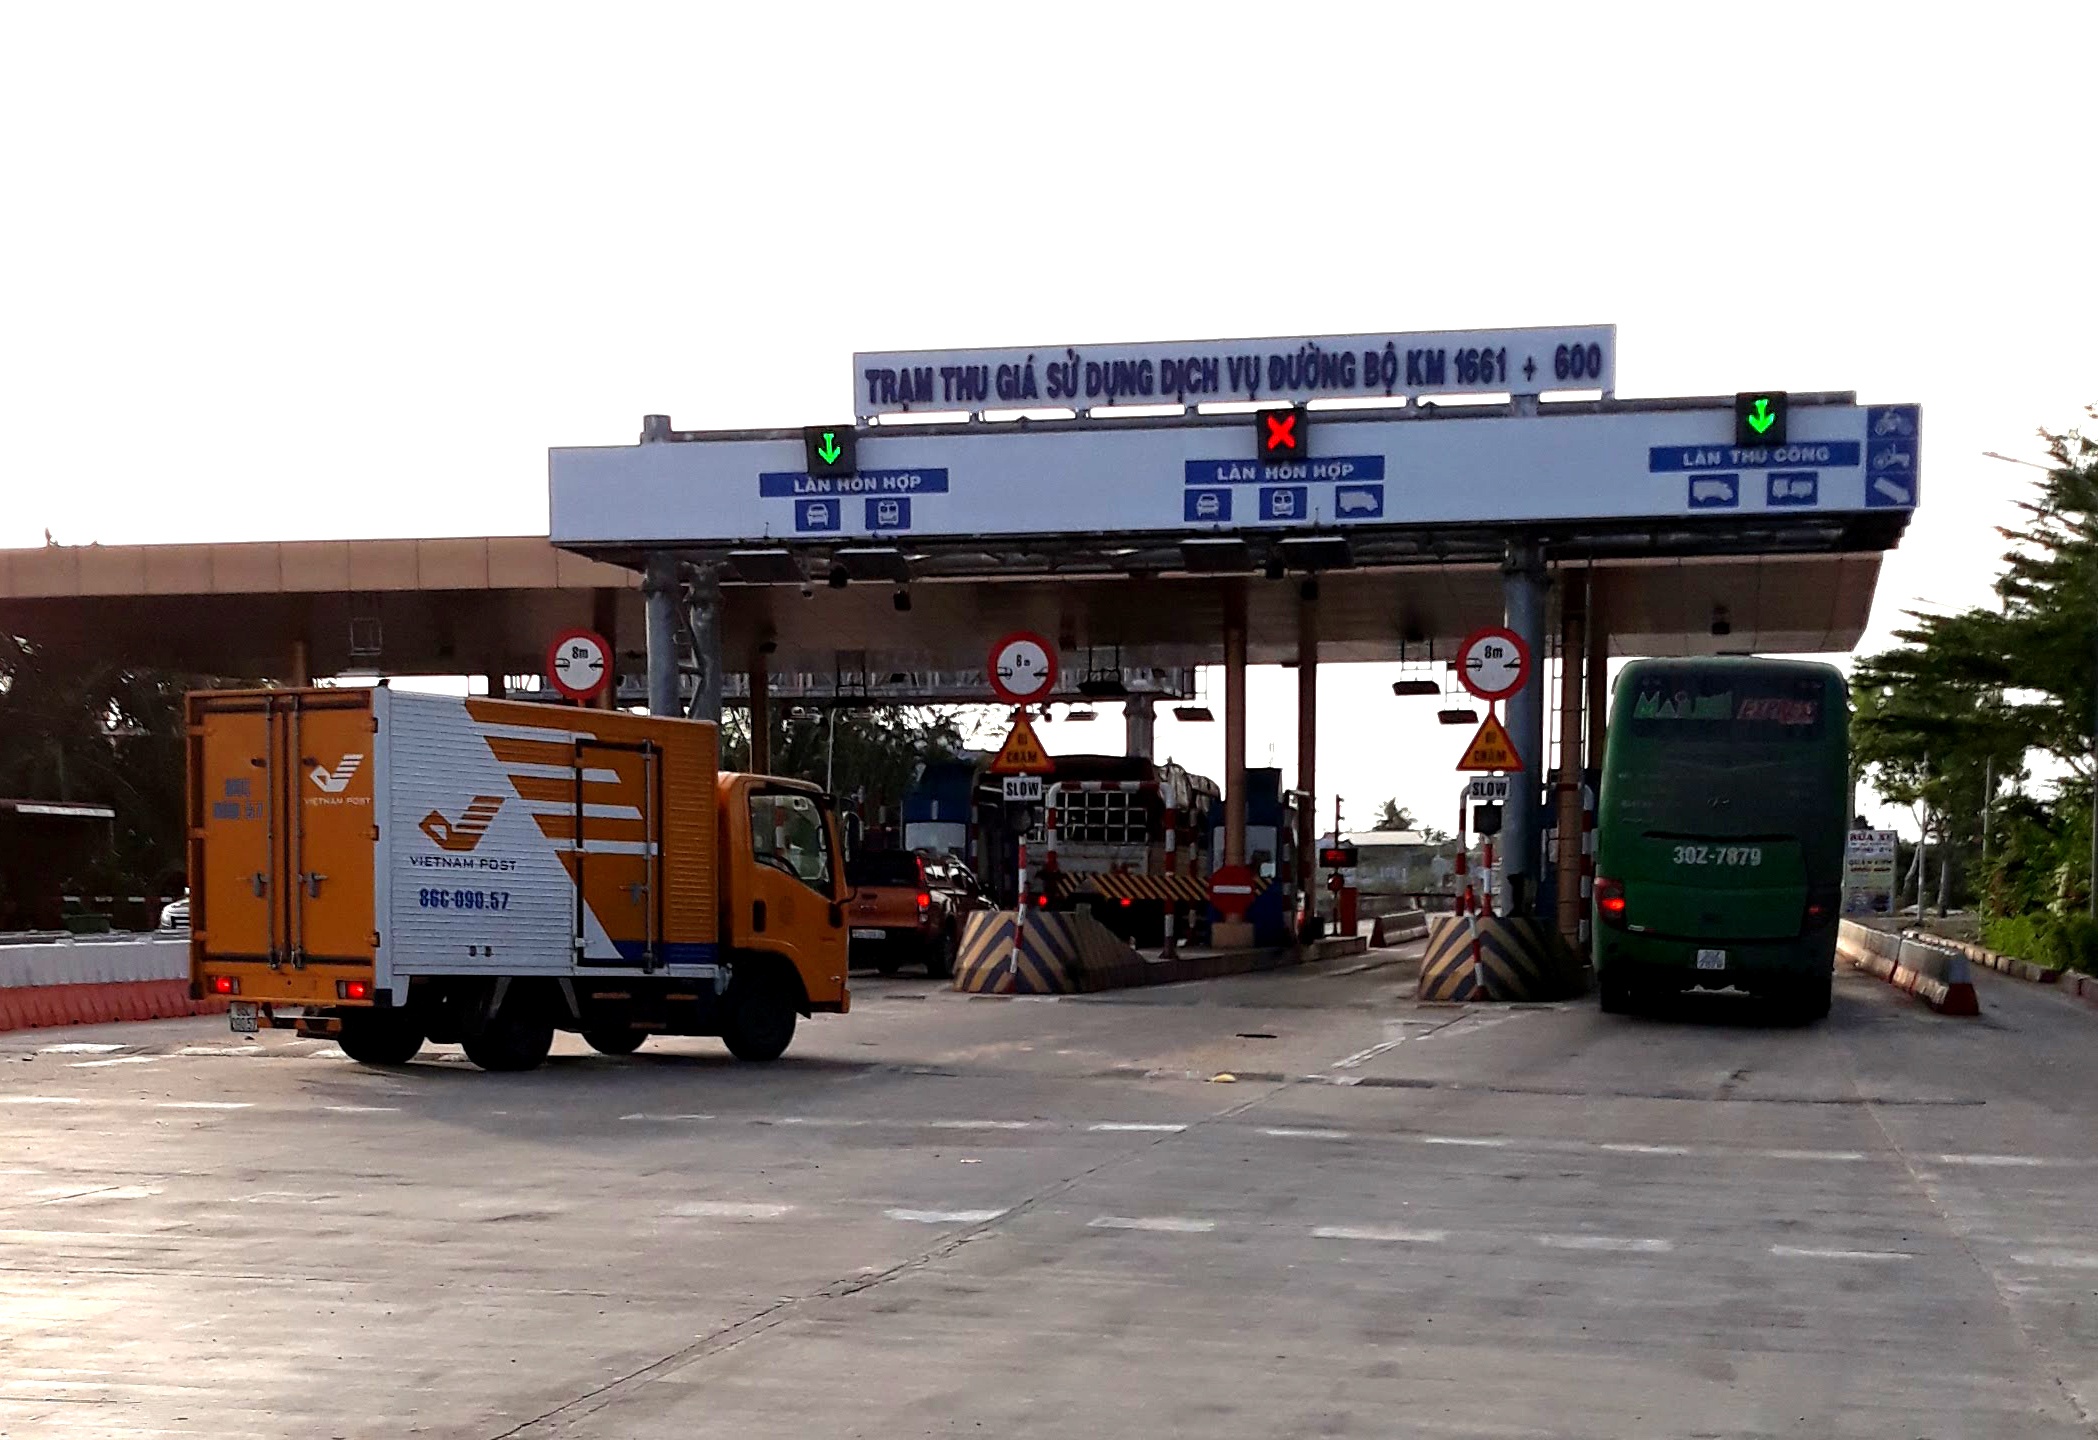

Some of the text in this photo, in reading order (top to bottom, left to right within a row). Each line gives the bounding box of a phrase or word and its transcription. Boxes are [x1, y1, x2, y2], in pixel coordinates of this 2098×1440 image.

[865, 341, 1603, 411] TRẠM THU GIÁ SỬ DỤNG DỊCH VỤ ĐƯỜNG BỘ KM 1661 + 600
[571, 646, 589, 659] 8m
[1484, 645, 1504, 659] 8m
[1006, 781, 1039, 797] SLOW
[1472, 781, 1507, 797] SLOW
[409, 855, 517, 871] VIETNAM POST
[1673, 846, 1762, 867] 30Z-7879
[419, 888, 510, 911] 86C-090.57
